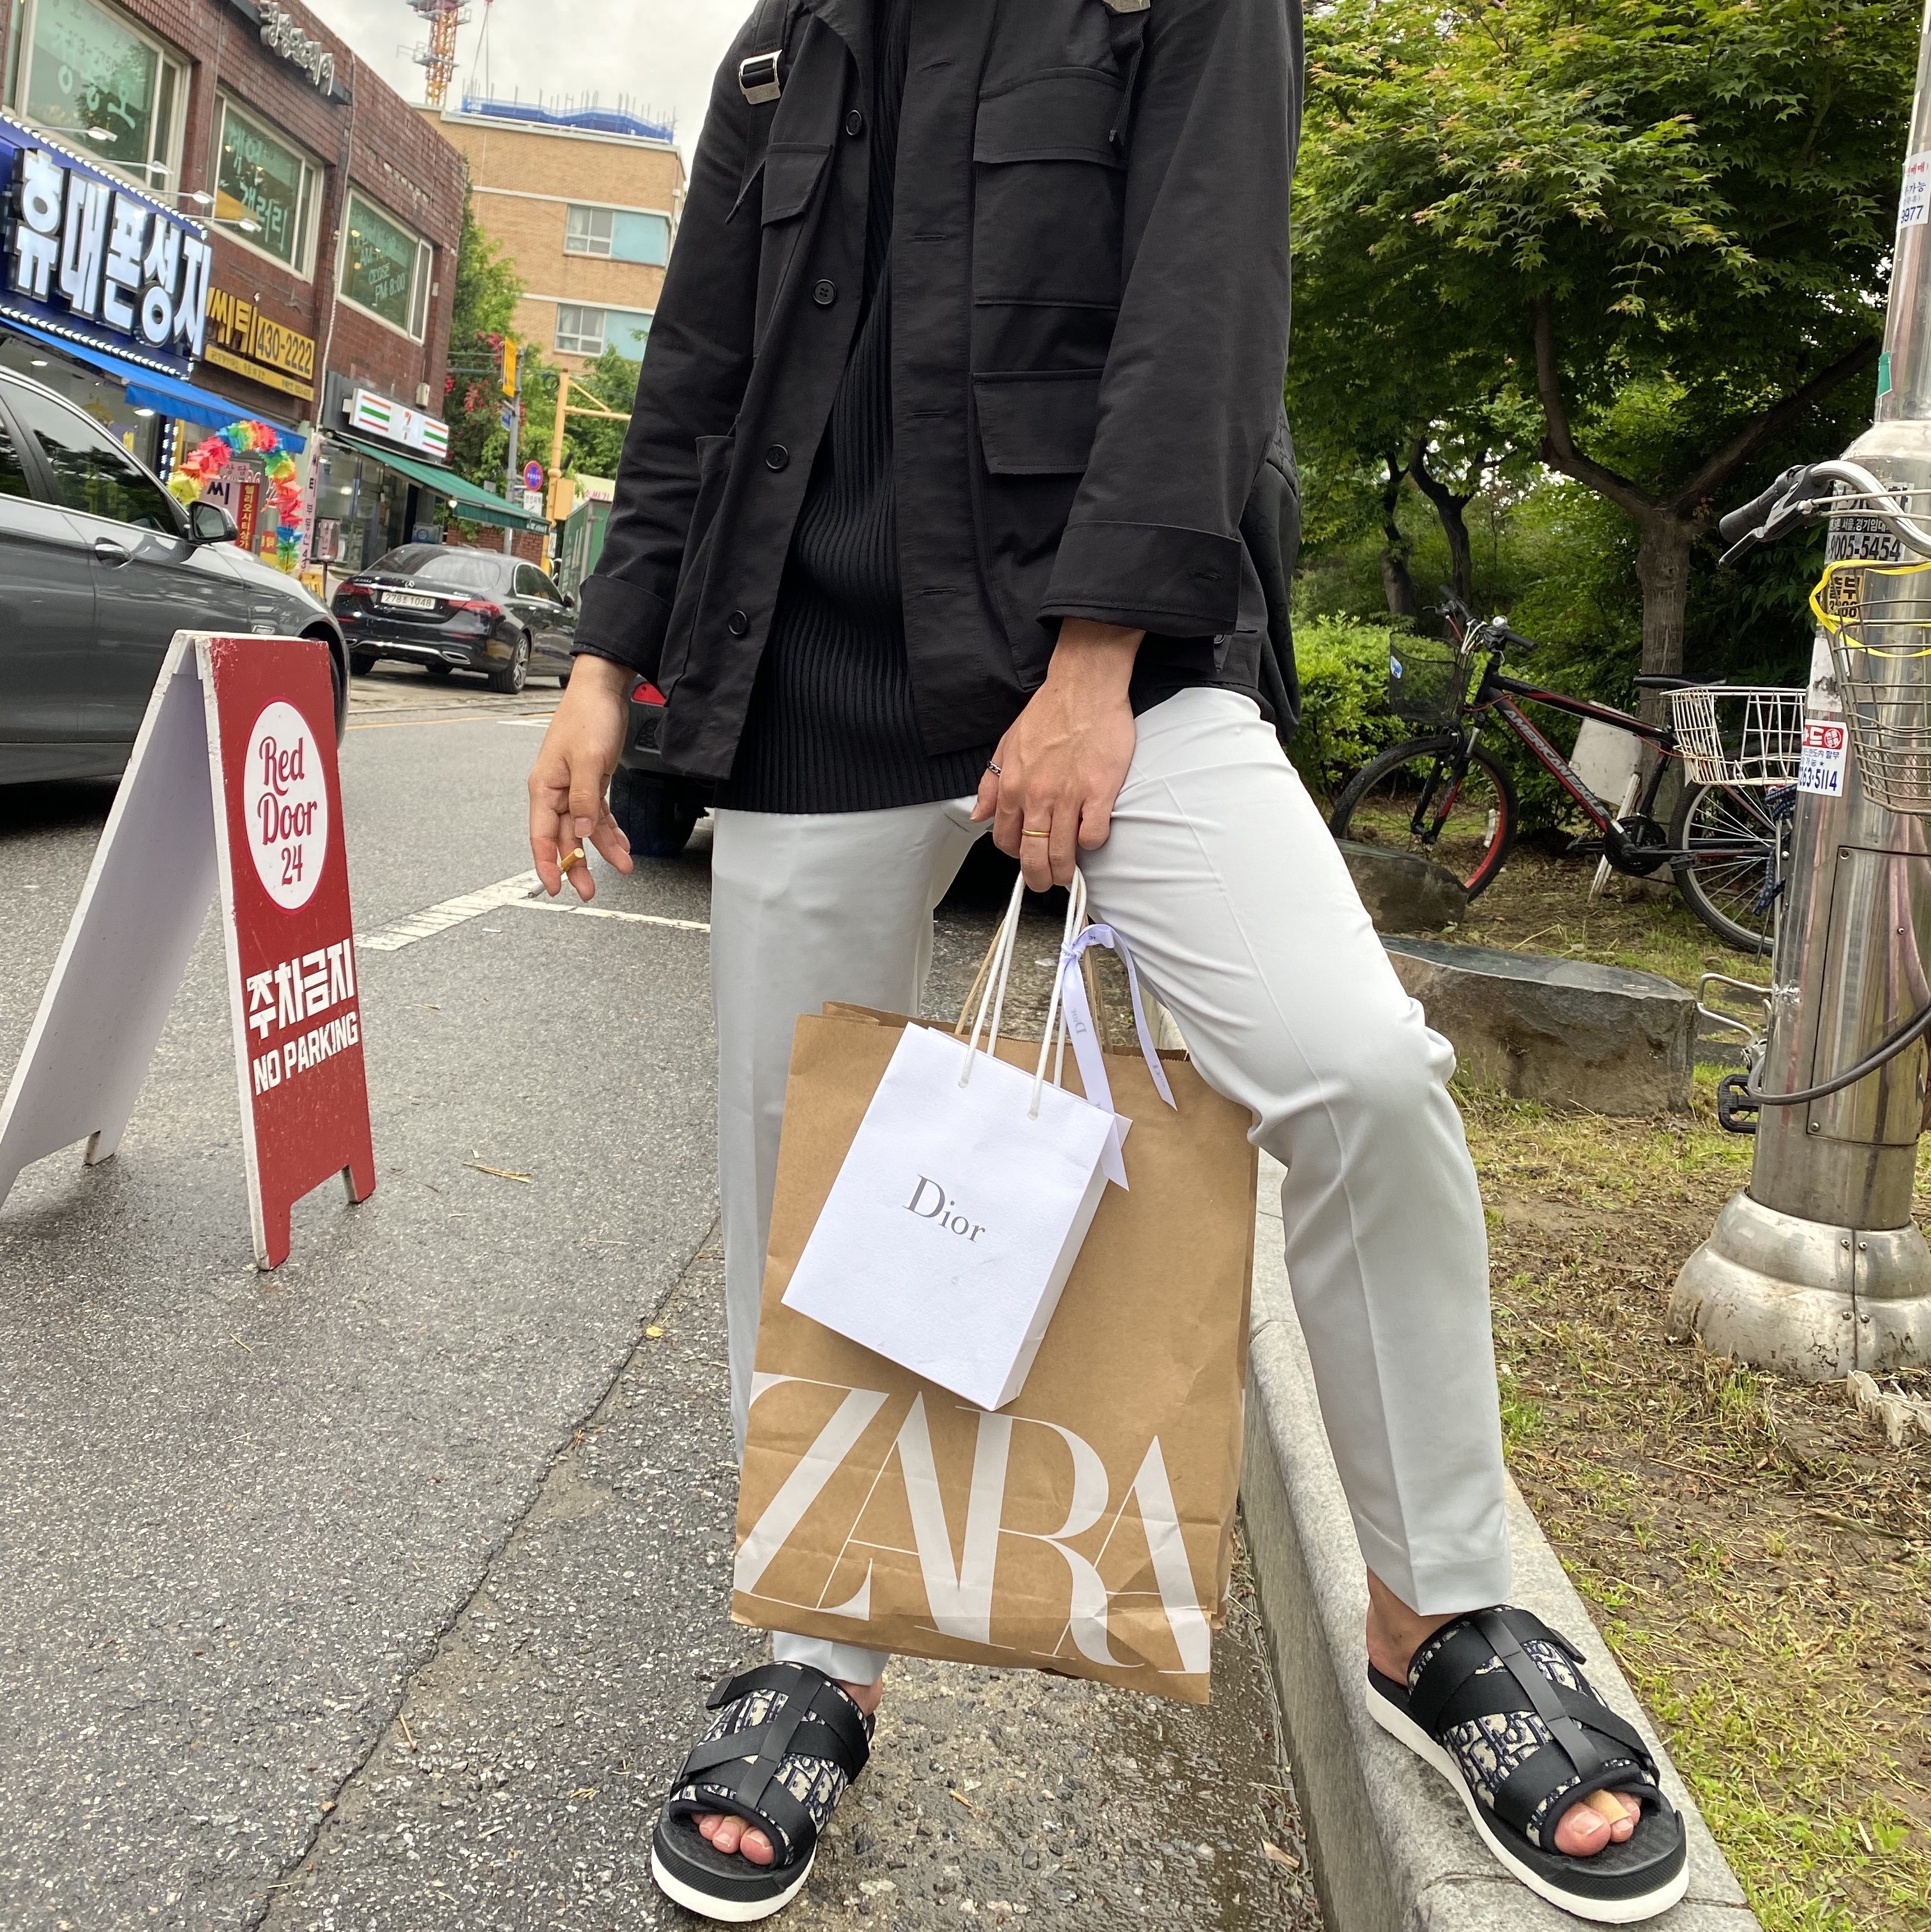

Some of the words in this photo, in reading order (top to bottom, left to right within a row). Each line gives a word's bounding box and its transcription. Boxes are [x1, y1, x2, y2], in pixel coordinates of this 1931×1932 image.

[17, 149, 212, 360] 휴대폰성지
[257, 321, 312, 375] 430-2222
[225, 464, 247, 476] 상담
[410, 598, 432, 607] 1048
[259, 736, 305, 796] Red
[257, 792, 317, 846] Door
[282, 844, 303, 886] 24
[246, 938, 355, 1040] 주차금지
[1071, 1008, 1087, 1035] Dior
[253, 1049, 282, 1096] NO
[283, 1011, 359, 1079] PARKING
[902, 1173, 986, 1243] Dior
[732, 1371, 1211, 1675] ZARA
